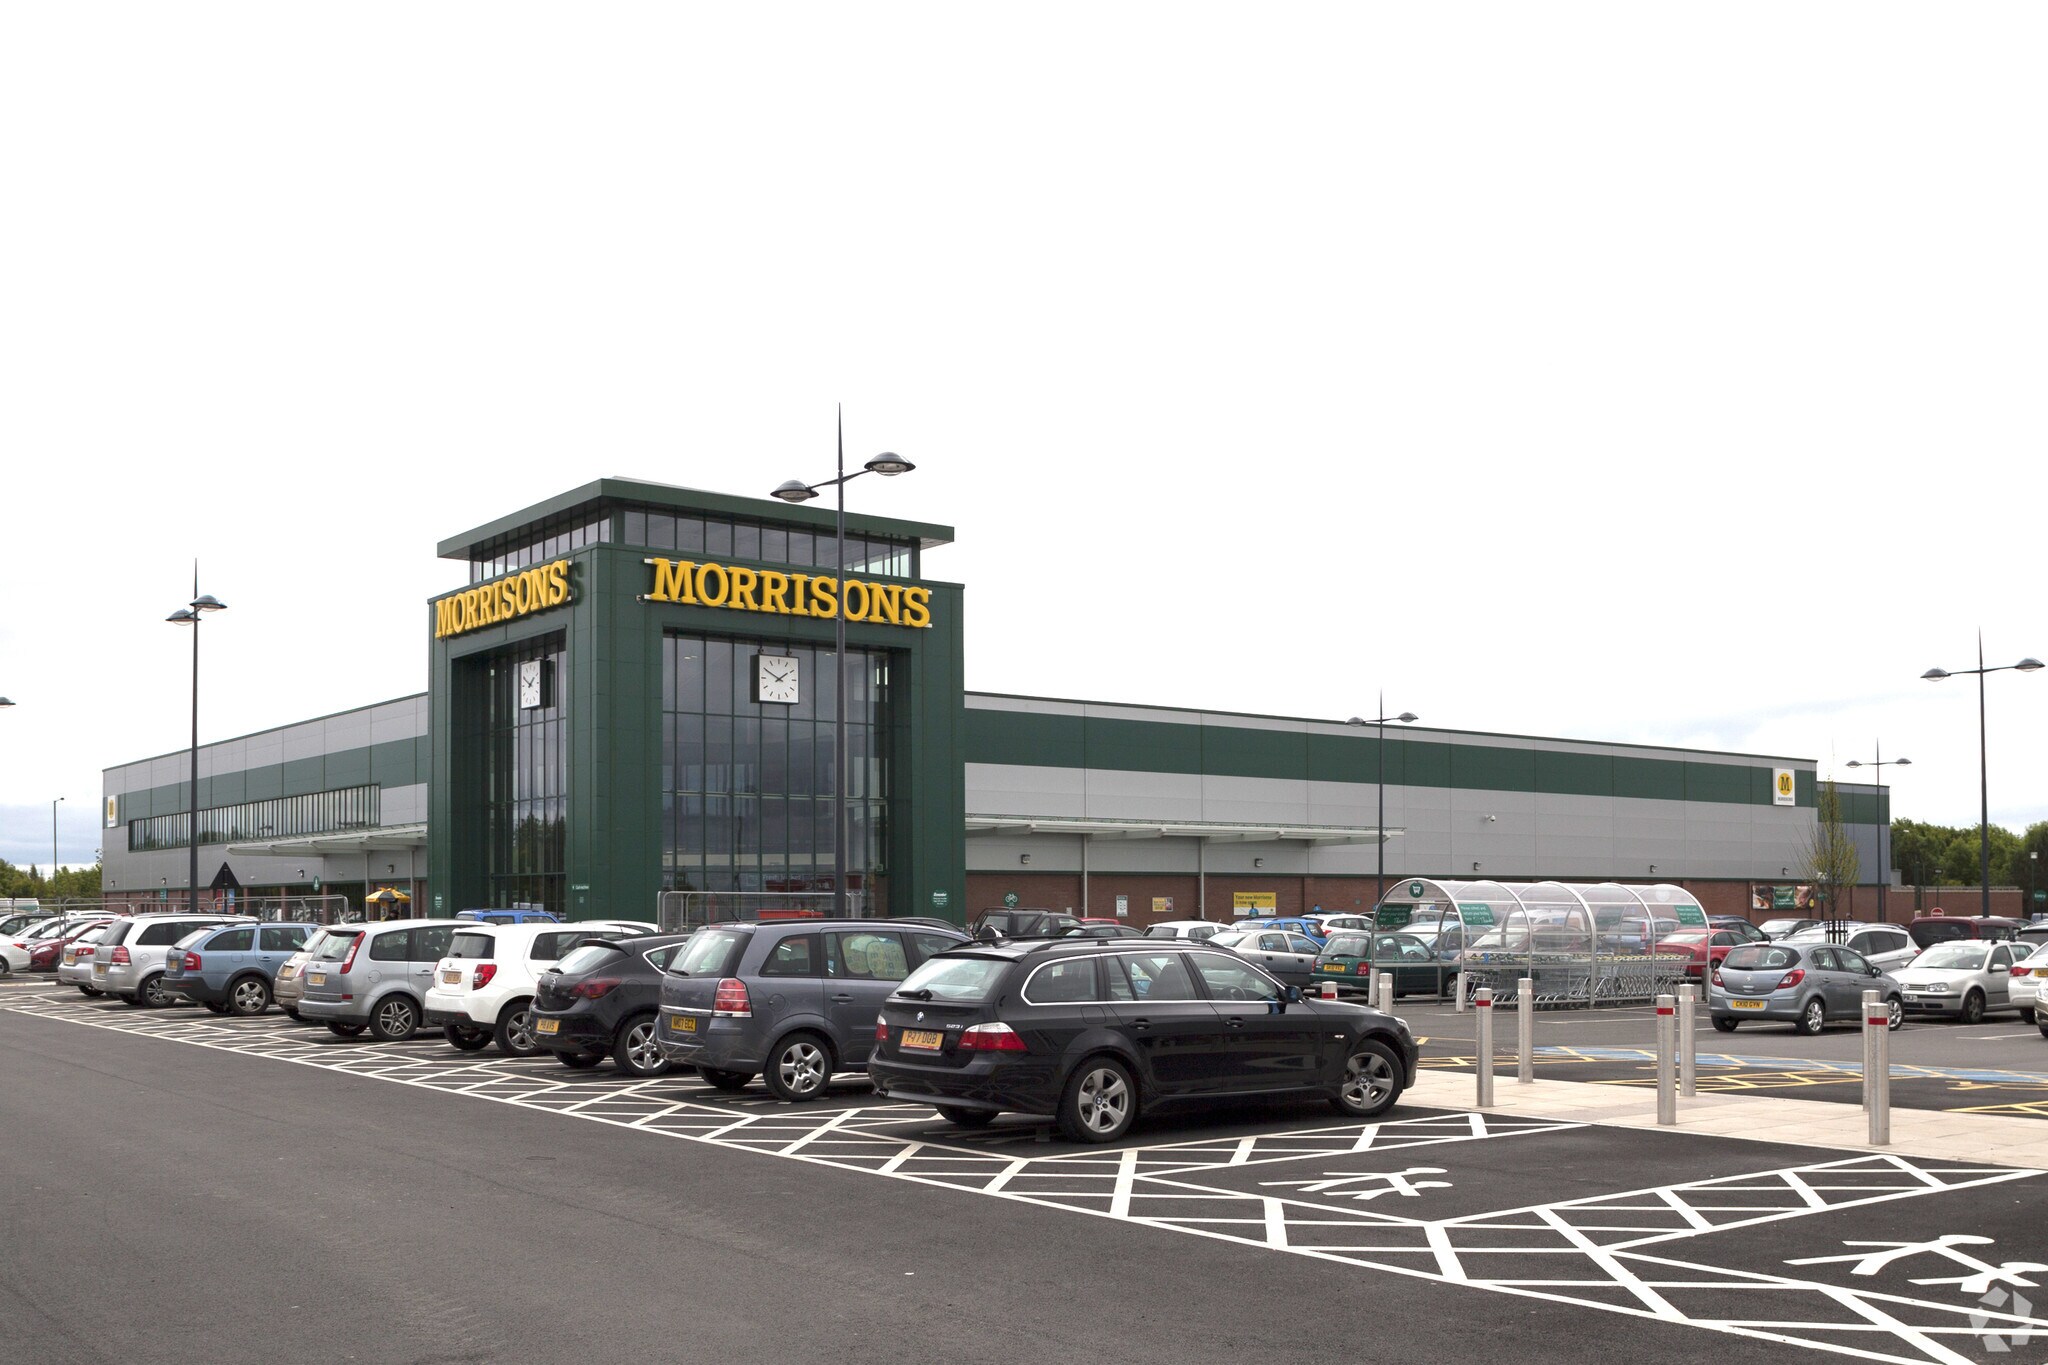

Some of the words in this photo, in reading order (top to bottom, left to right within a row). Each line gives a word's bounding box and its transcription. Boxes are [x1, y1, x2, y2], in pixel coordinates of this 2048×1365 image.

[435, 560, 569, 638] MORRISONS
[650, 557, 931, 628] MORRISONS
[1780, 776, 1791, 791] M
